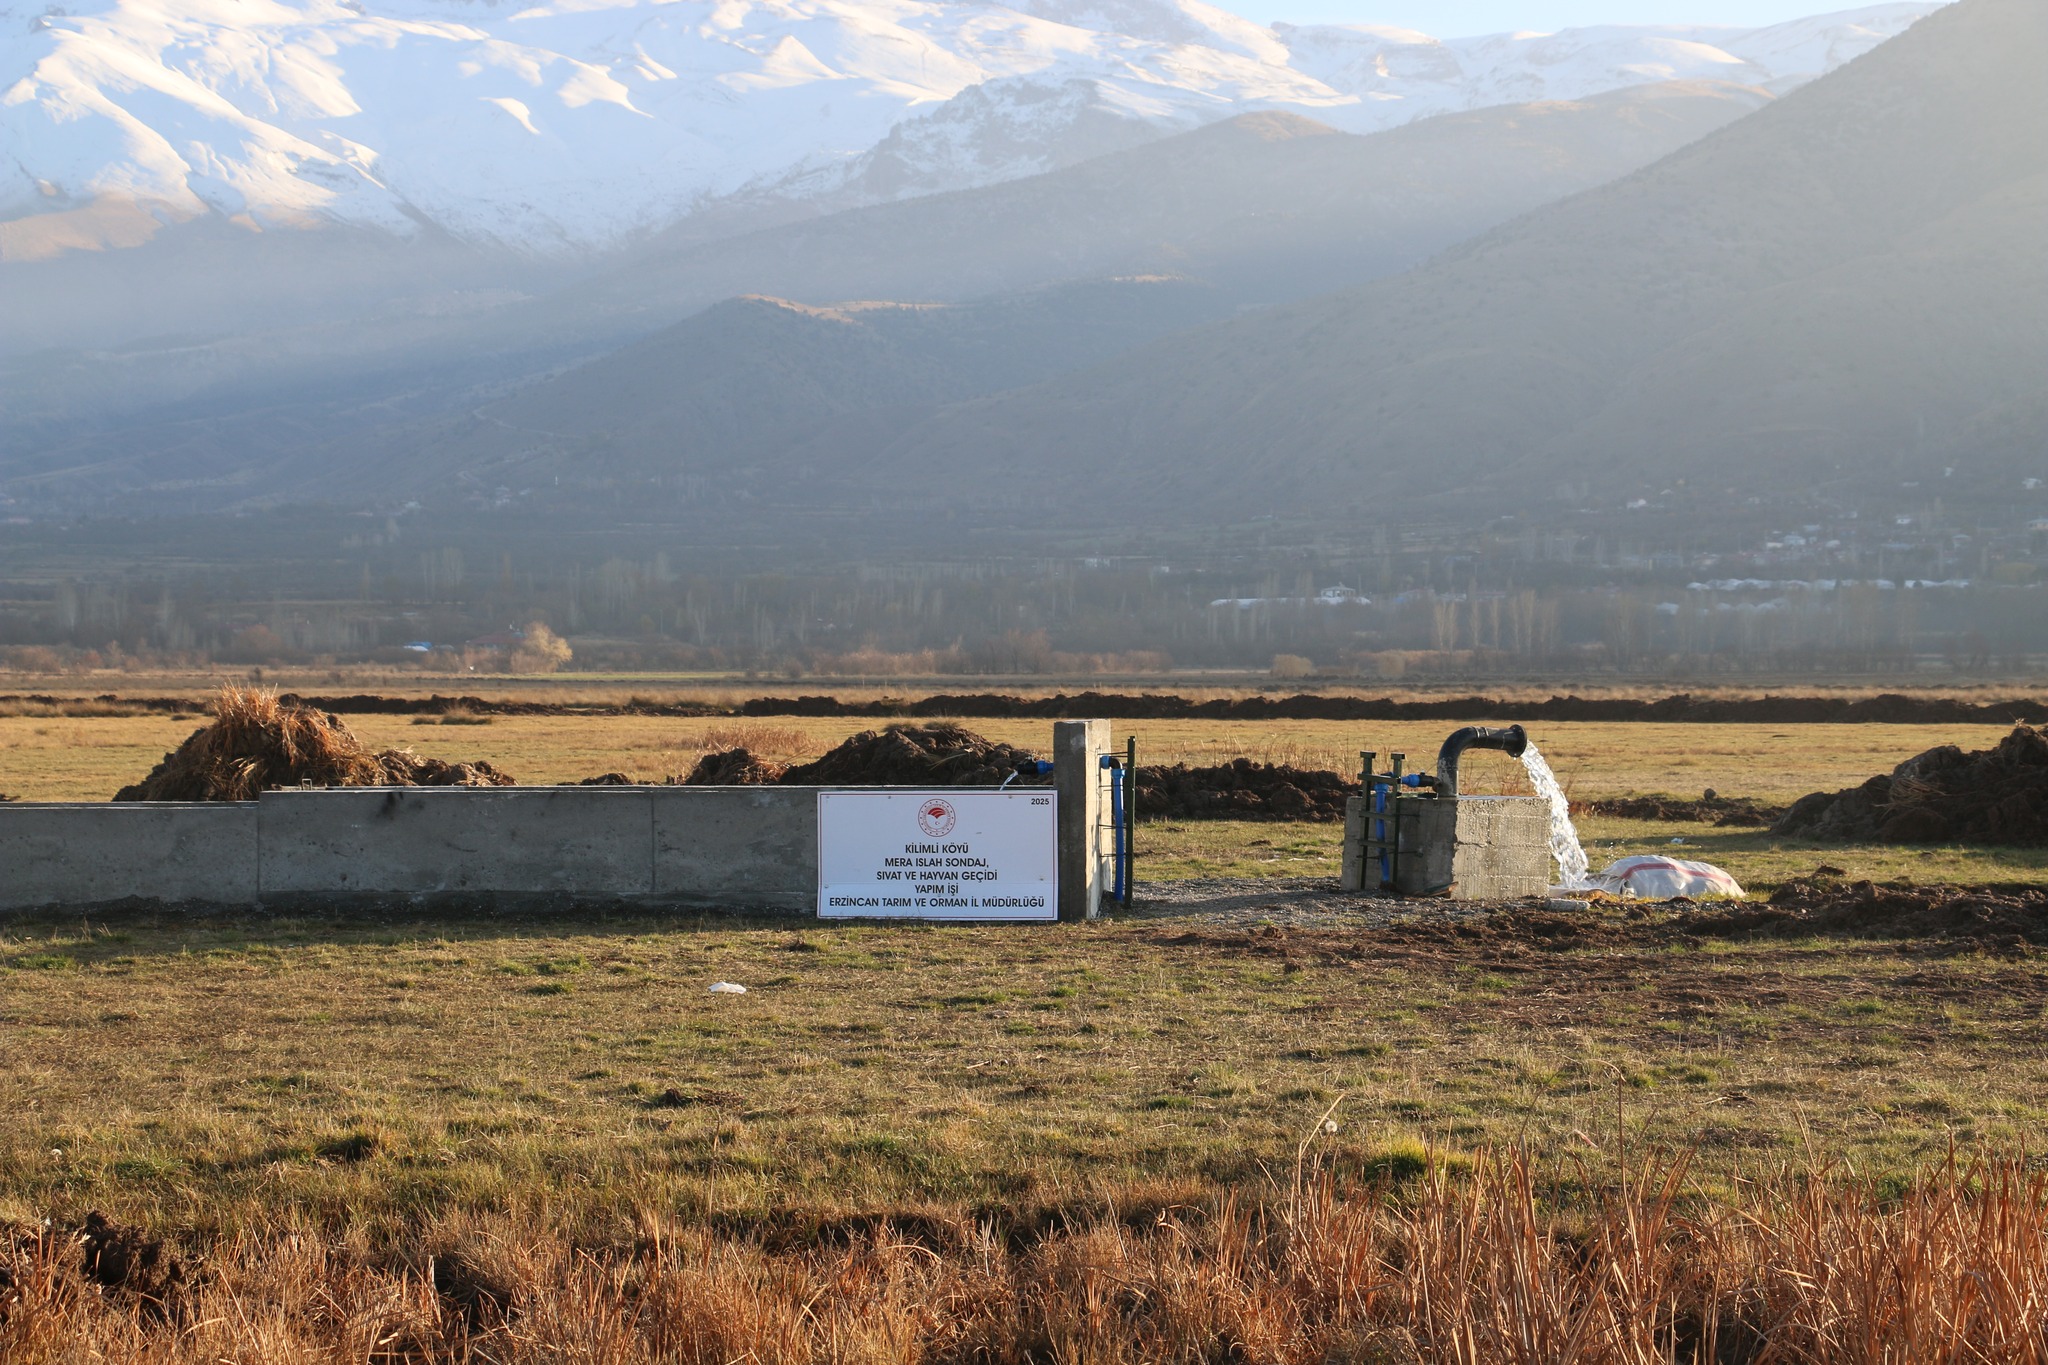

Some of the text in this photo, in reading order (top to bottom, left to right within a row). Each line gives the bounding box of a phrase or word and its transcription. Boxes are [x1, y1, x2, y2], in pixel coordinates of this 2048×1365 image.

[905, 842, 969, 854] KİLİMLİ KÖYÜ
[884, 858, 990, 868] MERA ISLAH SONDAJ,
[876, 869, 998, 883] SIVAT VE HAYVAN GEÇİDİ
[914, 883, 959, 896] YAPIM İŞİ
[829, 895, 1045, 908] ERZİNCAN TARIM VE ORMAN İL MÜDÜRLÜĞÜ
